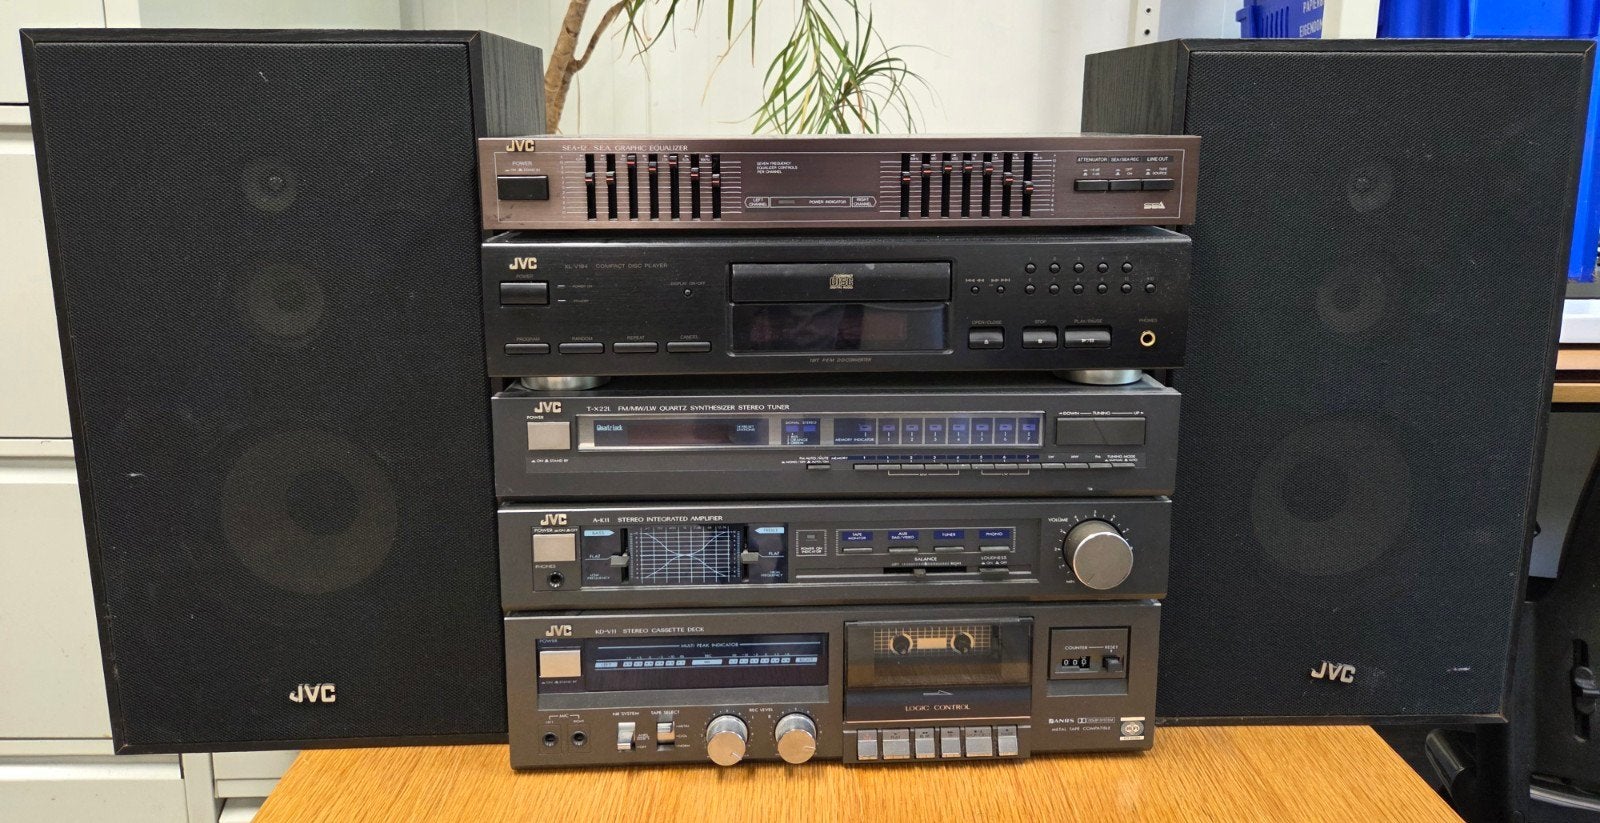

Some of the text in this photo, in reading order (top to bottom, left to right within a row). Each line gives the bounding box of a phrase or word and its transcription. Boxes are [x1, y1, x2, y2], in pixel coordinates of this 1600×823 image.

[506, 139, 535, 152] JVC
[509, 257, 537, 270] JVC
[534, 401, 561, 413] JVC
[540, 513, 567, 525] JVC
[545, 625, 572, 637] JVC
[1310, 661, 1356, 683] JVC
[289, 684, 336, 702] JVC
[933, 703, 971, 711] CONTROL
